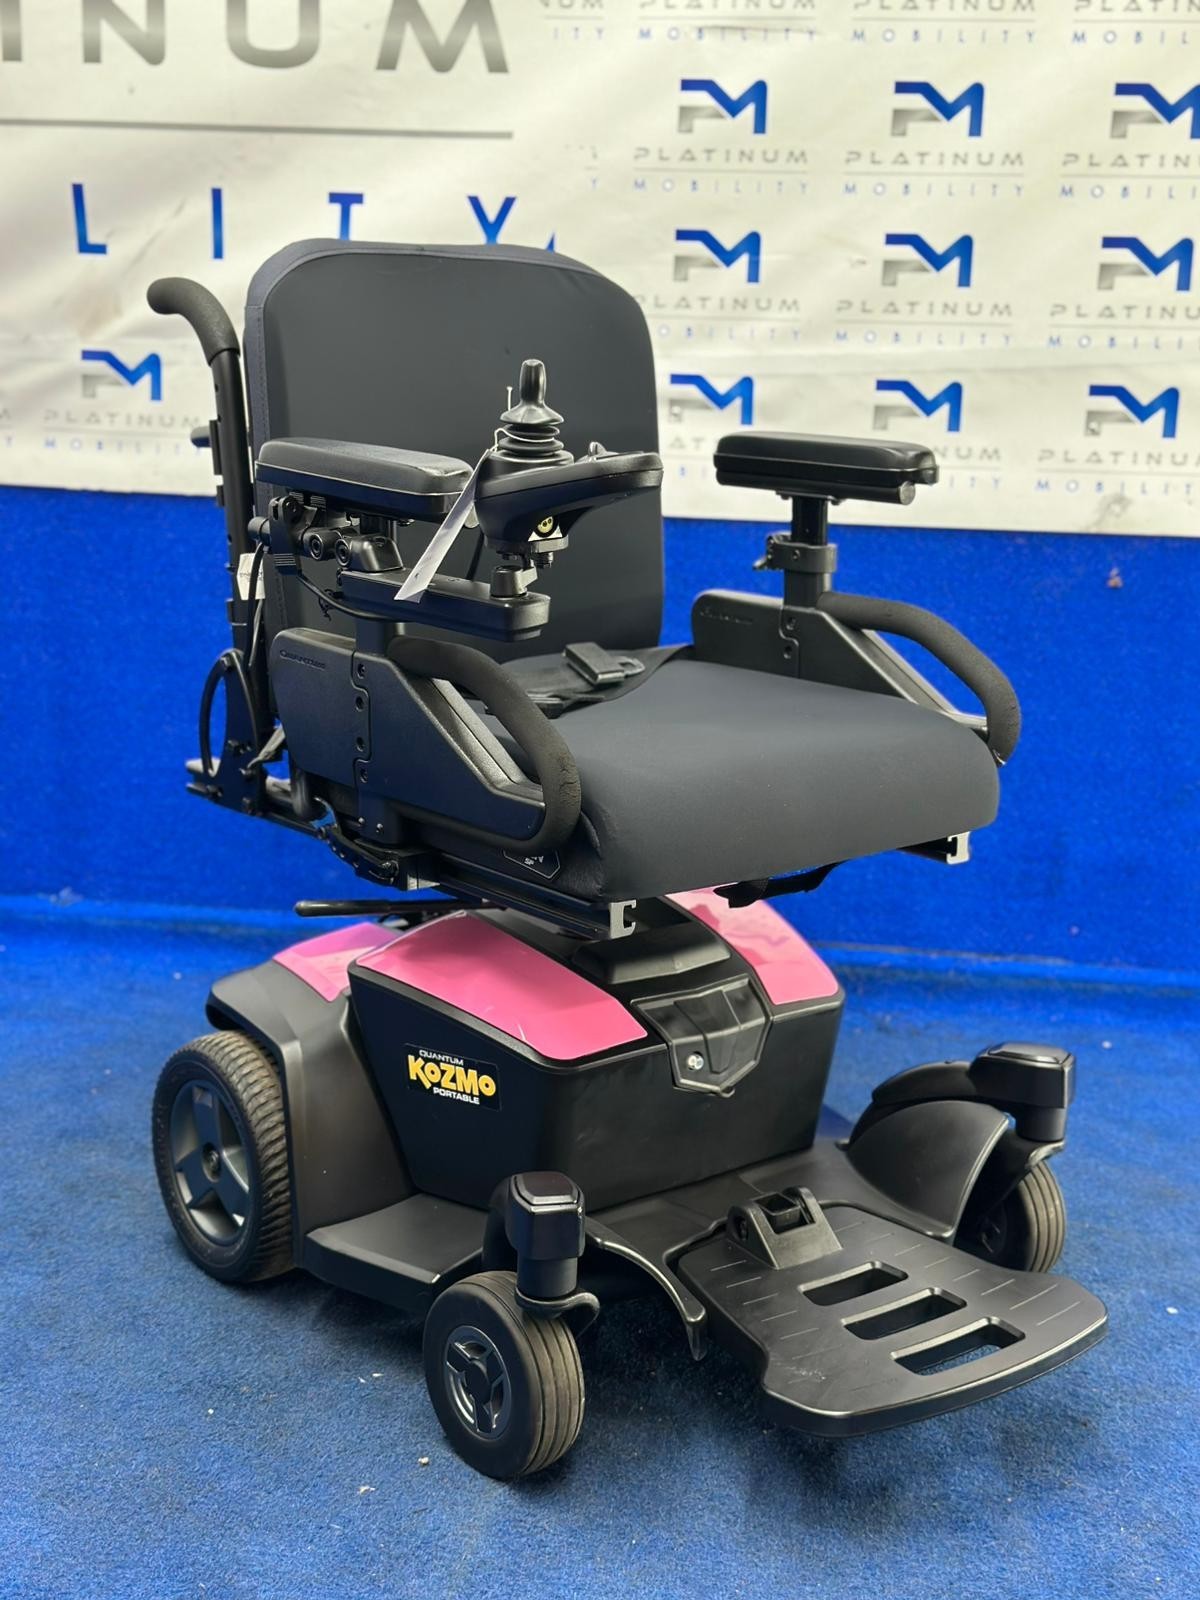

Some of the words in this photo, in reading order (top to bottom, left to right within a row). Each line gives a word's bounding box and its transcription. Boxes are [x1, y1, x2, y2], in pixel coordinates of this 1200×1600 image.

[852, 29, 1037, 44] MOBILITY
[633, 148, 808, 164] PLATINUM
[844, 151, 1024, 167] PLATINUM
[1062, 153, 1200, 168] PLATIN
[632, 179, 808, 193] MOBILITY
[843, 181, 1025, 197] MOBILITY
[835, 300, 1012, 317] PLATINUM
[833, 330, 1013, 346] MOBILITY
[1037, 449, 1200, 467] PLATINU
[419, 1049, 464, 1066] QUANTUM
[432, 1086, 480, 1105] PORTABLE
